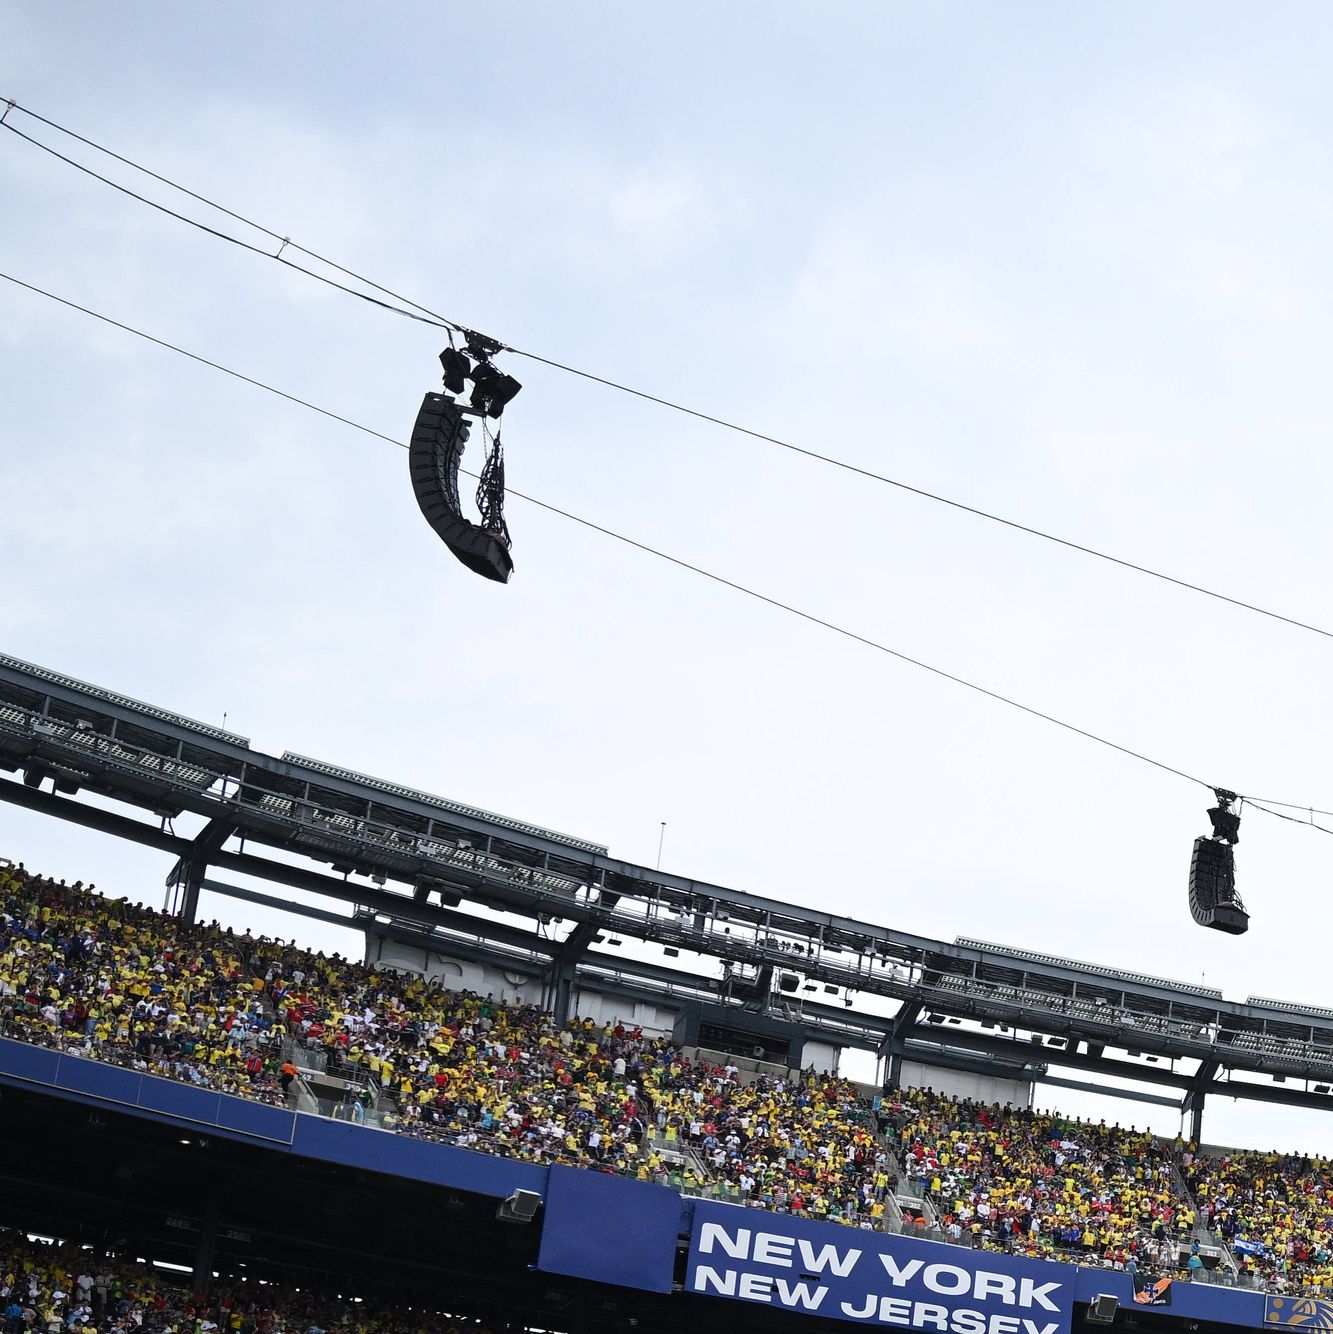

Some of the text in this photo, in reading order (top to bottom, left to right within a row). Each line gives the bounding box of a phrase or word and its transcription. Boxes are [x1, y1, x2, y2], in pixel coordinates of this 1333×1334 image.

[694, 1265, 830, 1310] NEW
[699, 1222, 1063, 1312] NEW YORK
